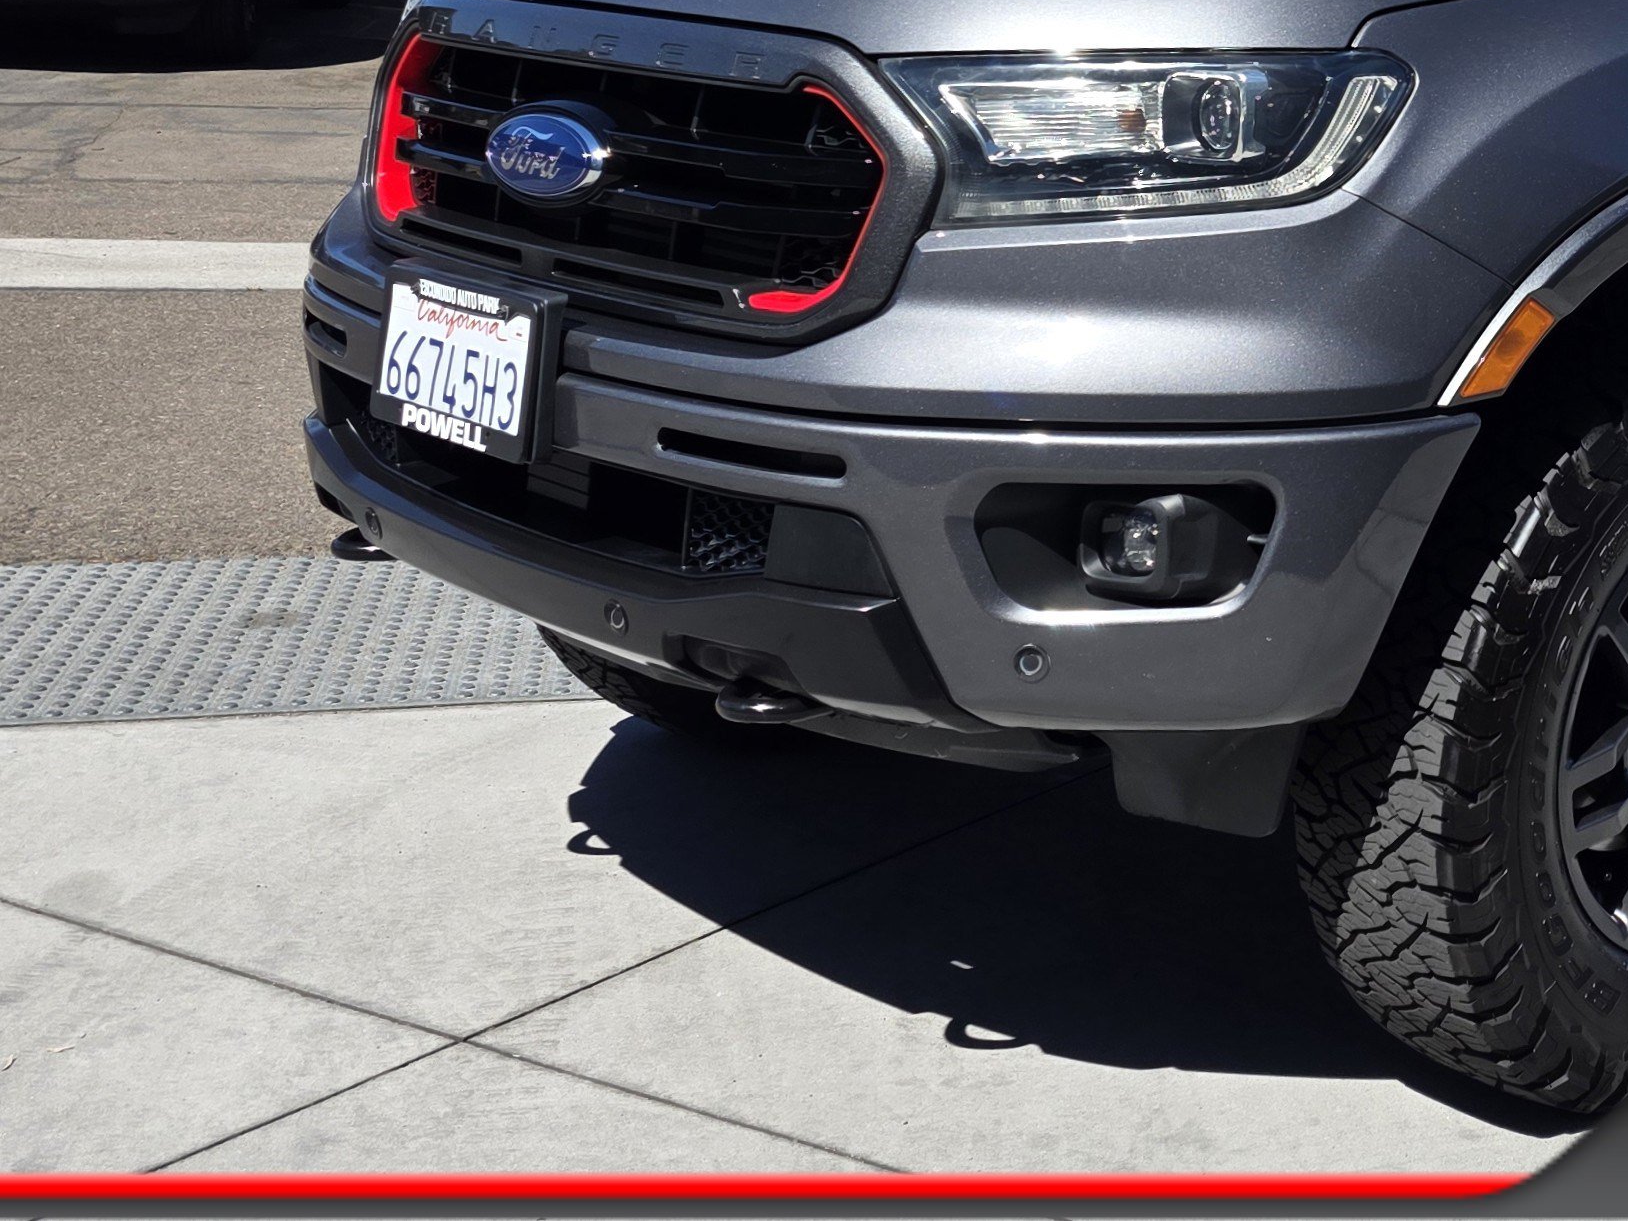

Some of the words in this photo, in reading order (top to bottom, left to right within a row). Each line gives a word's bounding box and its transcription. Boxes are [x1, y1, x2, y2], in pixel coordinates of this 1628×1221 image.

[425, 11, 768, 79] RANGER
[500, 125, 566, 180] Ford
[417, 298, 508, 341] California
[457, 288, 477, 310] AUTO
[478, 293, 500, 315] PARK
[386, 330, 518, 430] 66745H3
[401, 403, 487, 453] POWELL
